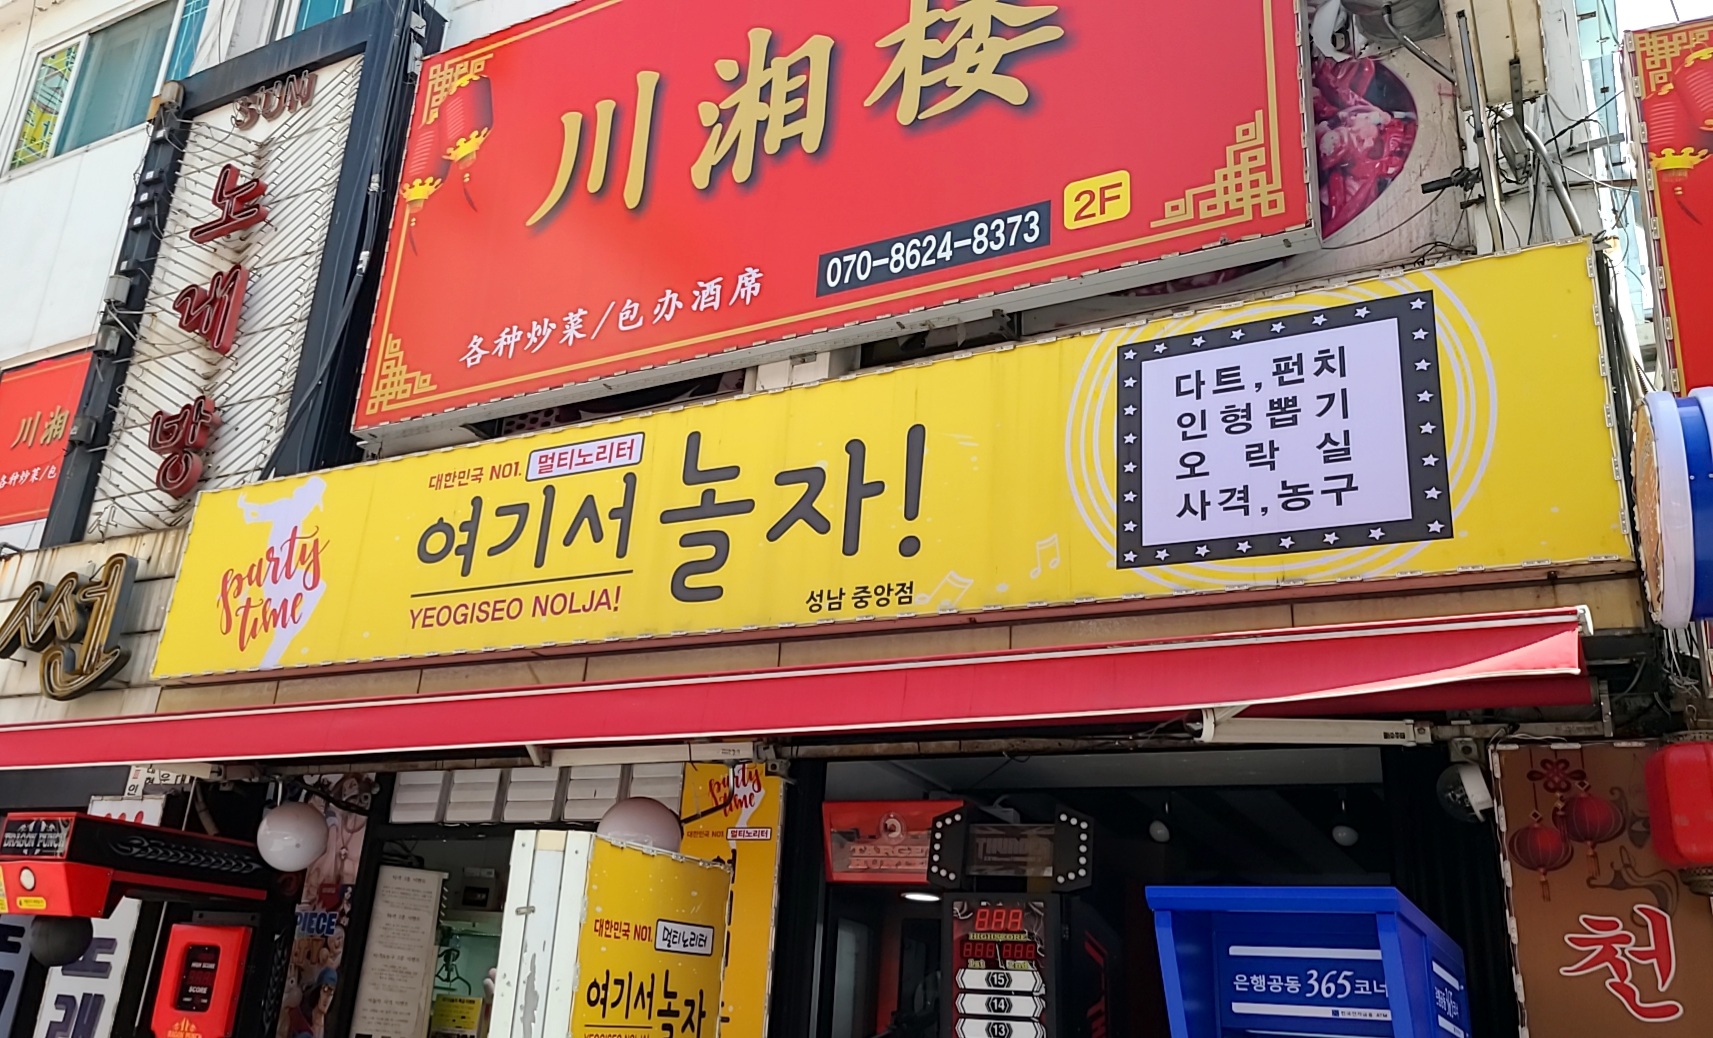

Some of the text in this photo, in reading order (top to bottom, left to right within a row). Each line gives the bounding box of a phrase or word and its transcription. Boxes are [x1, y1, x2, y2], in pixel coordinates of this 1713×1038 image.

[231, 70, 318, 131] SUN
[526, 0, 1064, 227] 川湘楼
[1073, 181, 1123, 221] 2F
[826, 210, 1042, 290] 070-8624-8373
[149, 163, 268, 497] 노래방
[458, 266, 764, 367] 各种炒菜/包办酒席
[428, 466, 485, 491] 대한민국
[537, 438, 636, 475] 멀티노리터
[417, 423, 925, 602] 여기서 놀자!
[217, 525, 330, 635] party
[805, 580, 915, 613] 성남 중앙점
[234, 592, 304, 653] time
[409, 585, 621, 630] YEOGISEO NOLJA!
[594, 918, 631, 940] 대한민국
[662, 926, 708, 948] 멀티노리터
[993, 973, 1005, 986] 15
[1233, 974, 1302, 994] 은행공동
[1559, 904, 1684, 1022] 천
[587, 969, 655, 1020] 여기서
[993, 998, 1005, 1011] 14
[993, 1024, 1006, 1036] 13
